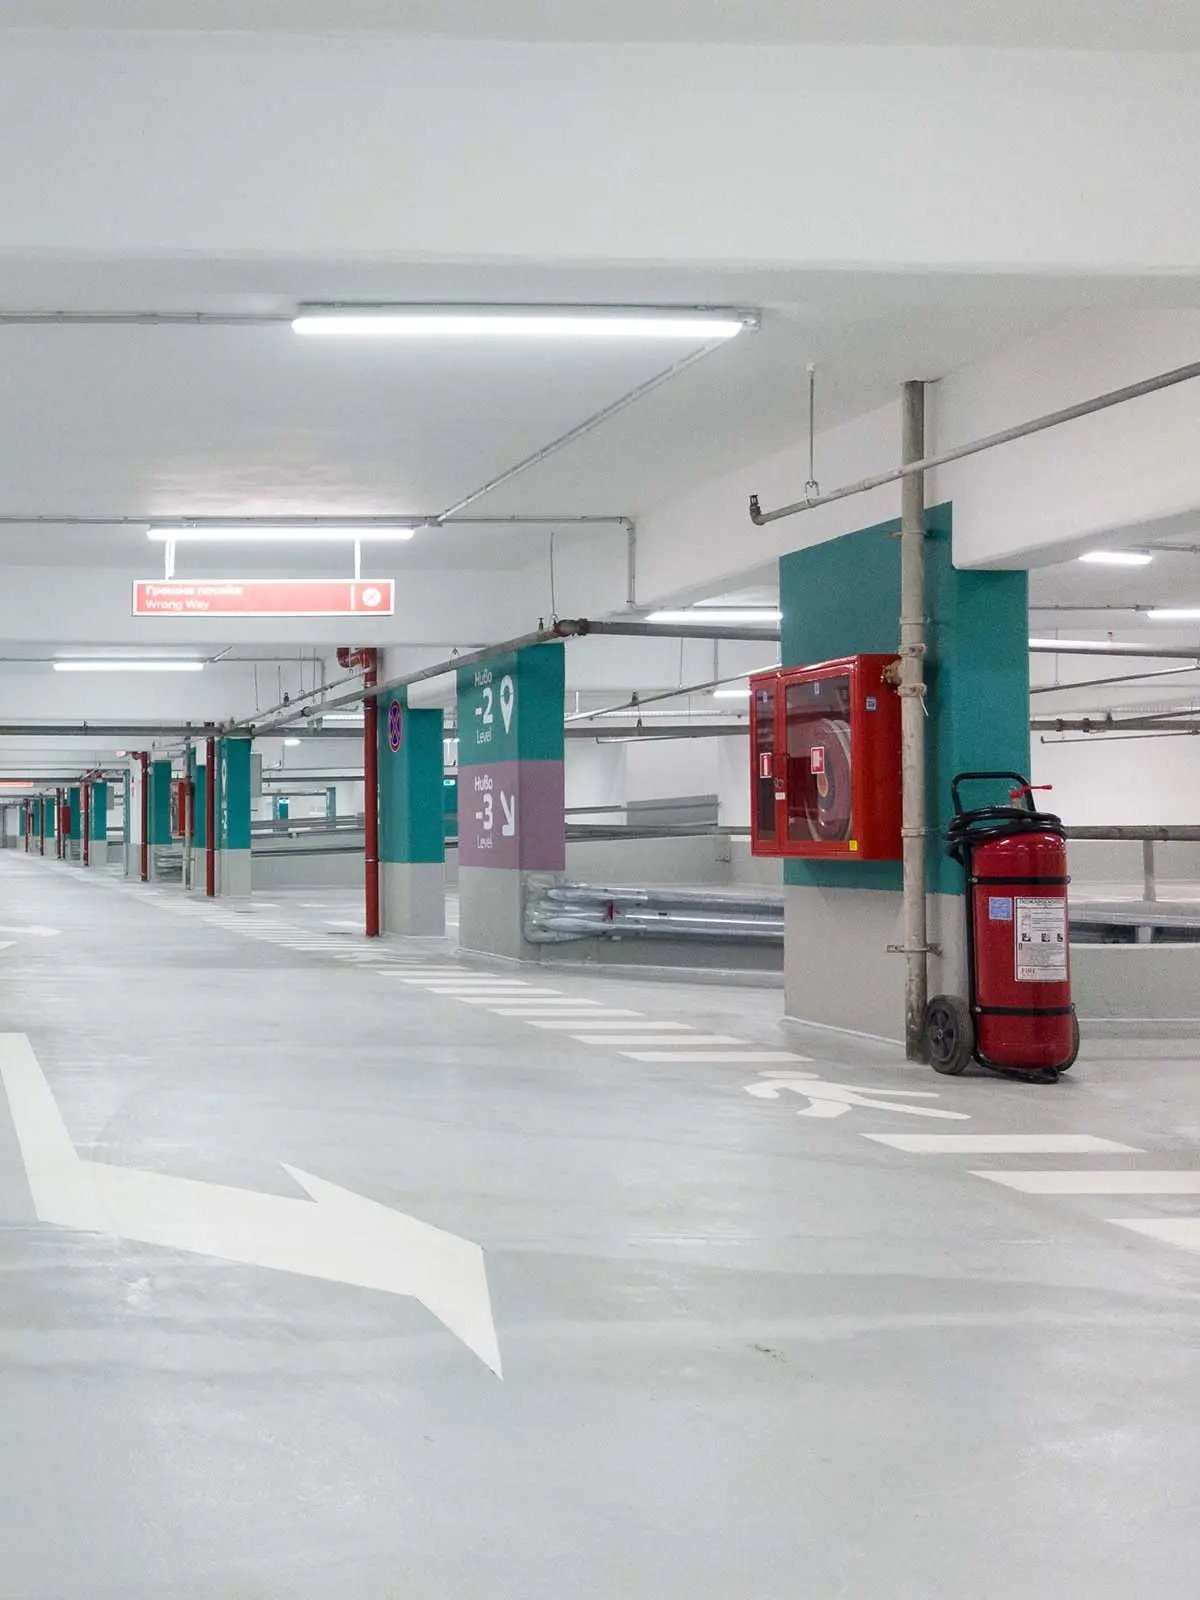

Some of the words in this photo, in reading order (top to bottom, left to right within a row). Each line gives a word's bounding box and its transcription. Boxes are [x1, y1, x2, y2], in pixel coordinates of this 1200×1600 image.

[145, 599, 183, 611] Wrong
[186, 599, 211, 611] Way
[475, 687, 493, 724] -2
[477, 727, 492, 744] Level
[475, 793, 493, 830] -3
[477, 832, 493, 849] Level
